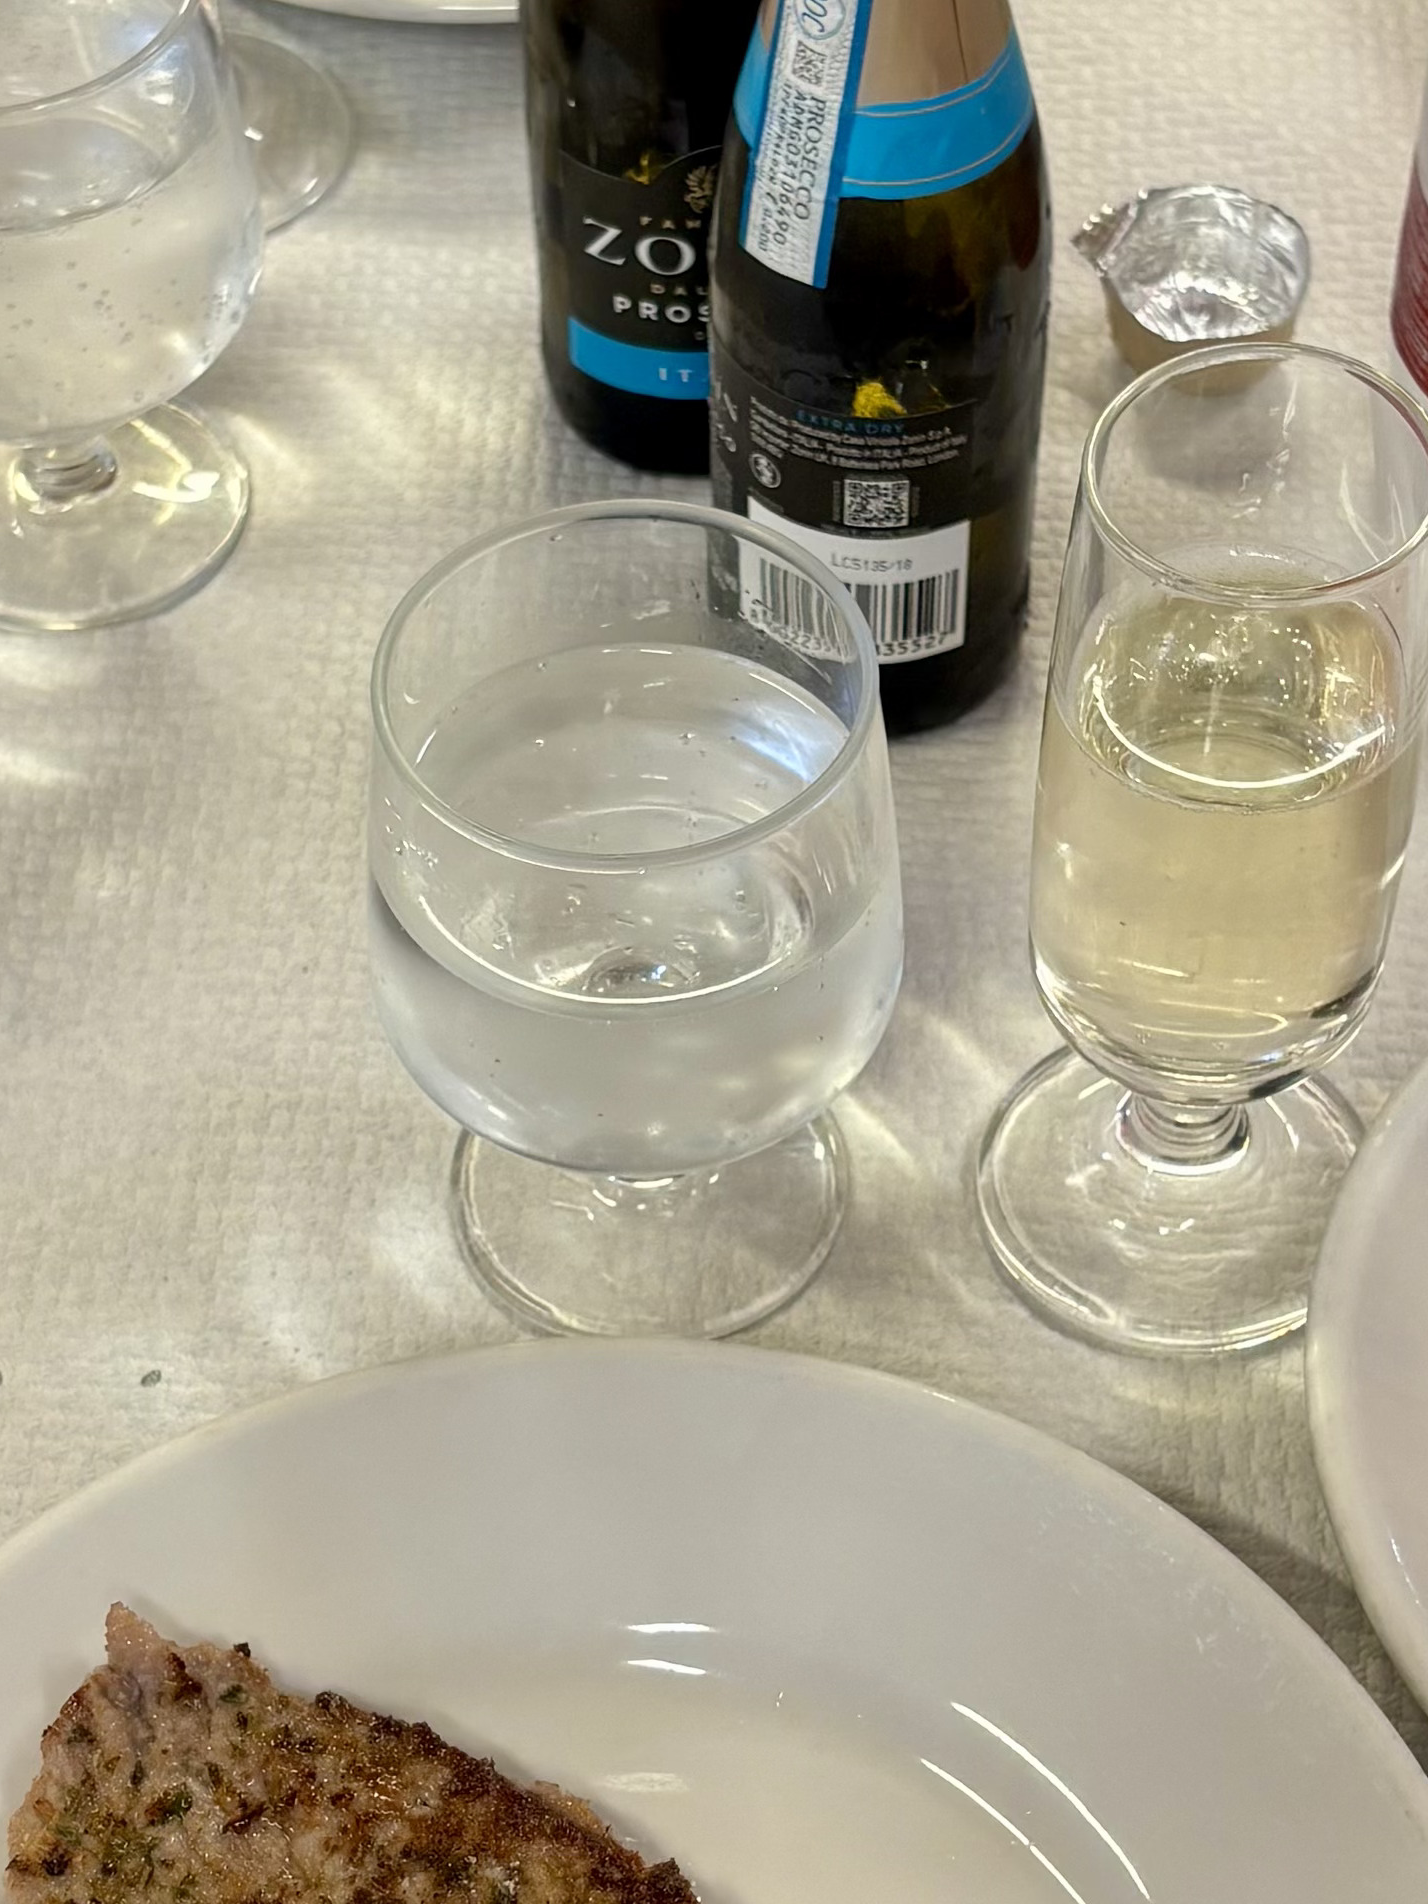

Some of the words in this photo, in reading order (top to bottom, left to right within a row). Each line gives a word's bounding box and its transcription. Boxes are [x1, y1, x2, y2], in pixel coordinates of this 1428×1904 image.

[792, 95, 827, 221] PROSECCO
[582, 215, 697, 276] ZO
[611, 294, 711, 324] PROS
